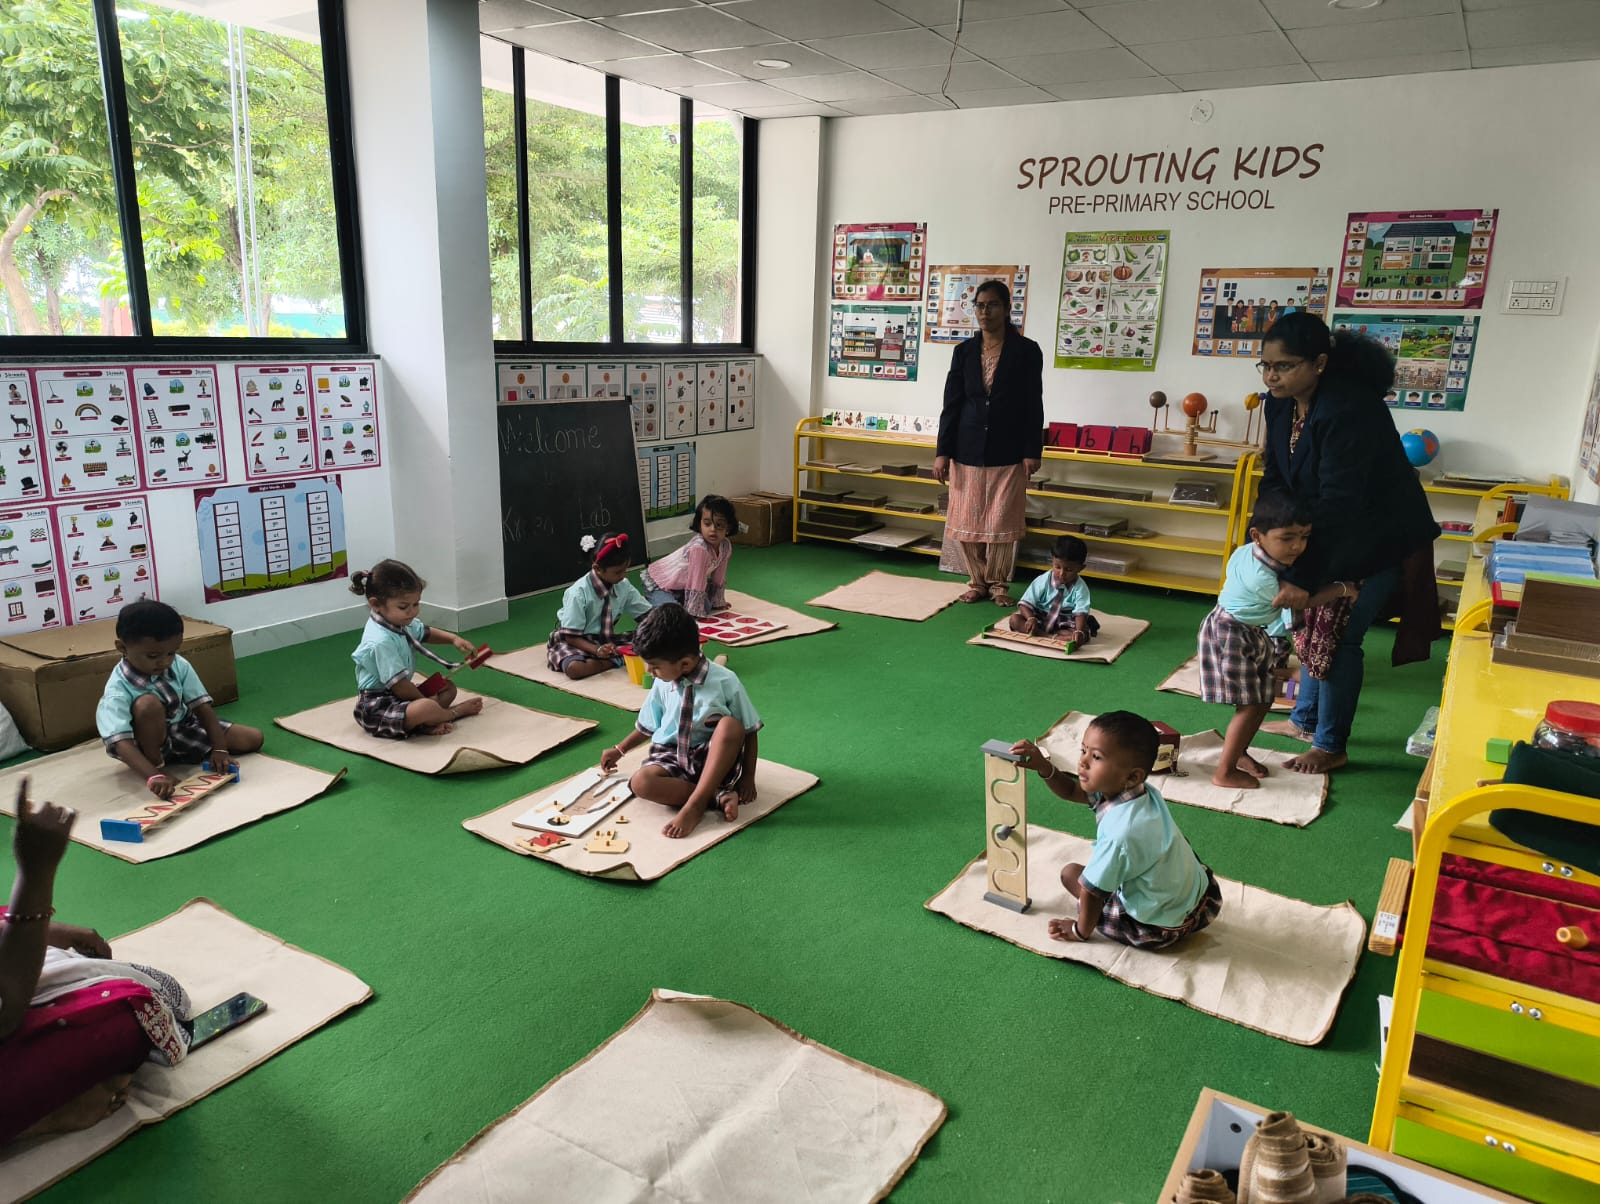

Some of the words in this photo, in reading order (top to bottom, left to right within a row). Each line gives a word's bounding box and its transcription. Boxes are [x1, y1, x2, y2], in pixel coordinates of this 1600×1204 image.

[1016, 147, 1220, 190] SPROUTING
[1233, 143, 1324, 181] KIDS
[1048, 191, 1182, 215] PRE-PRIMARY
[1186, 189, 1276, 211] SCHOOL
[1098, 234, 1156, 242] VEGETABLES
